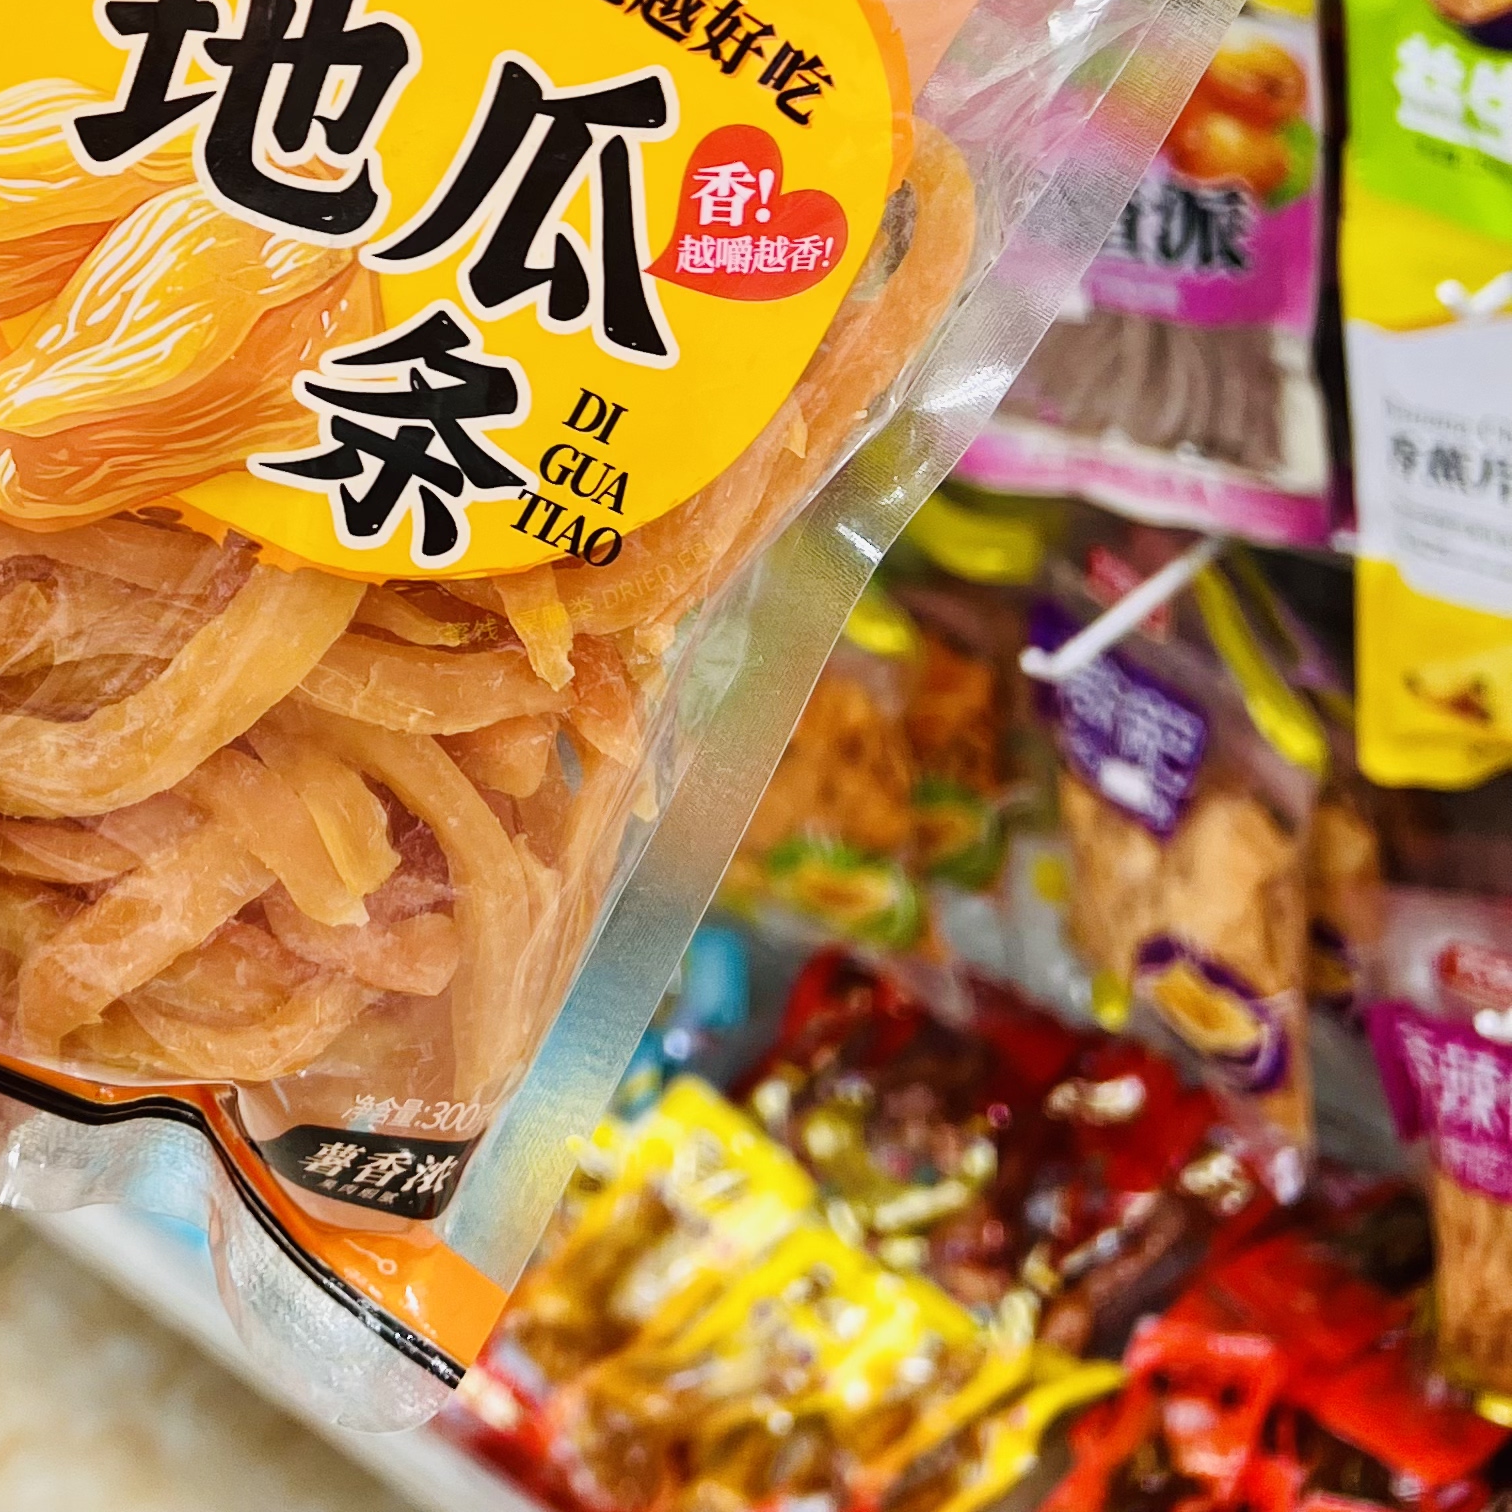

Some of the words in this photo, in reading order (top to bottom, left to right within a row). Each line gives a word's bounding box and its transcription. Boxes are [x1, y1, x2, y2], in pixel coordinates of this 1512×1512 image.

[689, 160, 775, 228] 香!
[674, 232, 832, 278] 越嚼越香!
[256, 308, 529, 557] 条
[561, 386, 629, 445] DI
[538, 442, 632, 518] GUA
[510, 487, 624, 570] TIAO
